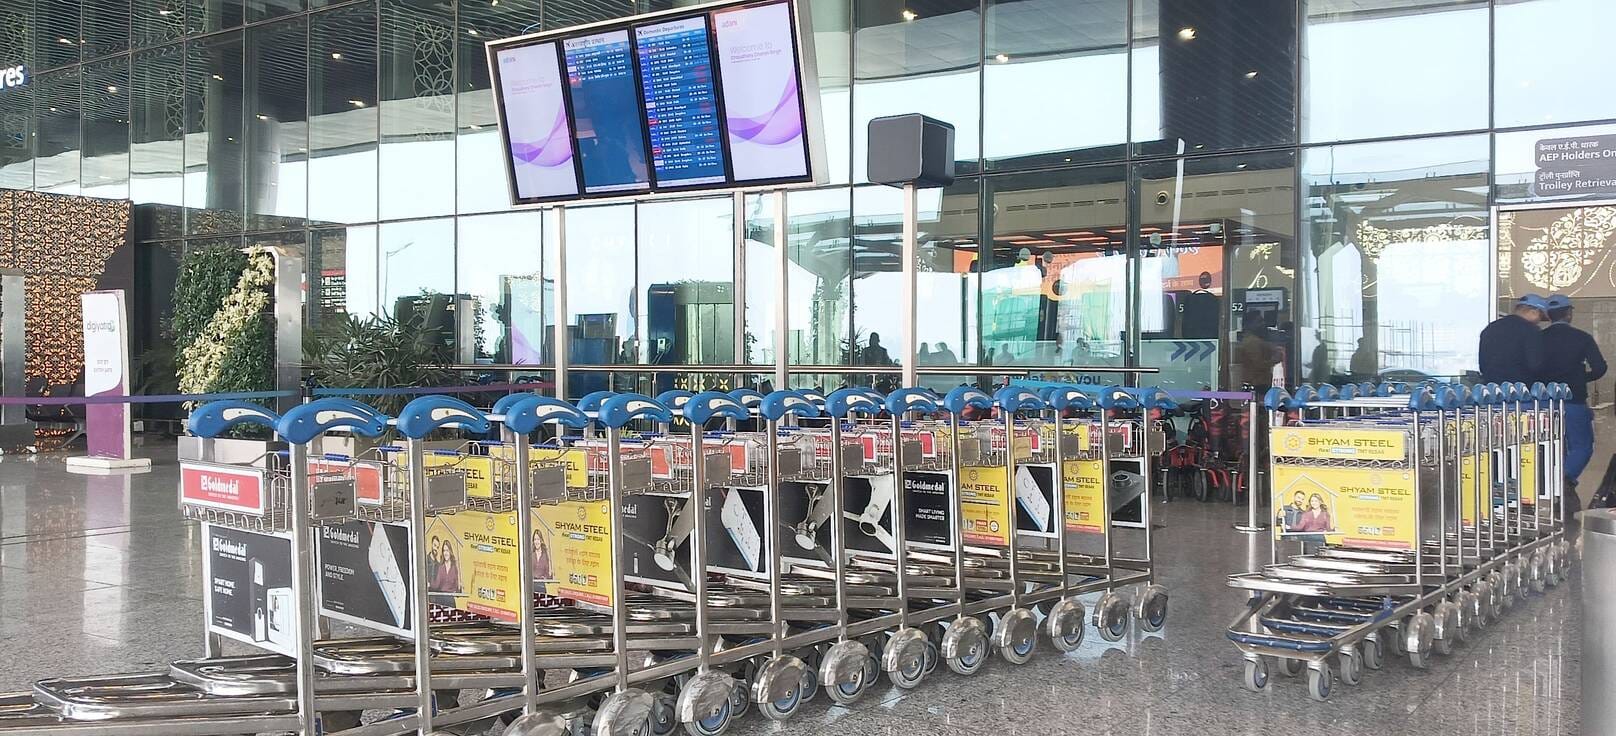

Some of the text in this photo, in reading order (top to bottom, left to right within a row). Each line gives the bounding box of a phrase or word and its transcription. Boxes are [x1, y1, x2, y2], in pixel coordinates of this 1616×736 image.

[1539, 153, 1559, 162] AEP
[1561, 150, 1601, 161] Holders
[1539, 181, 1573, 191] Trolley
[1232, 302, 1243, 312] 52
[1308, 437, 1395, 448] SHYAM STEEL
[207, 475, 239, 495] Goldmedal
[911, 480, 945, 492] Goldmedal
[975, 484, 1001, 492] STEEL
[1340, 486, 1411, 496] SHYAM STEEL
[555, 521, 609, 535] SHYAM STEEL
[330, 527, 360, 544] Goldmedal
[464, 532, 517, 548] SHYAM STEEL
[219, 537, 248, 557] Goldmedal
